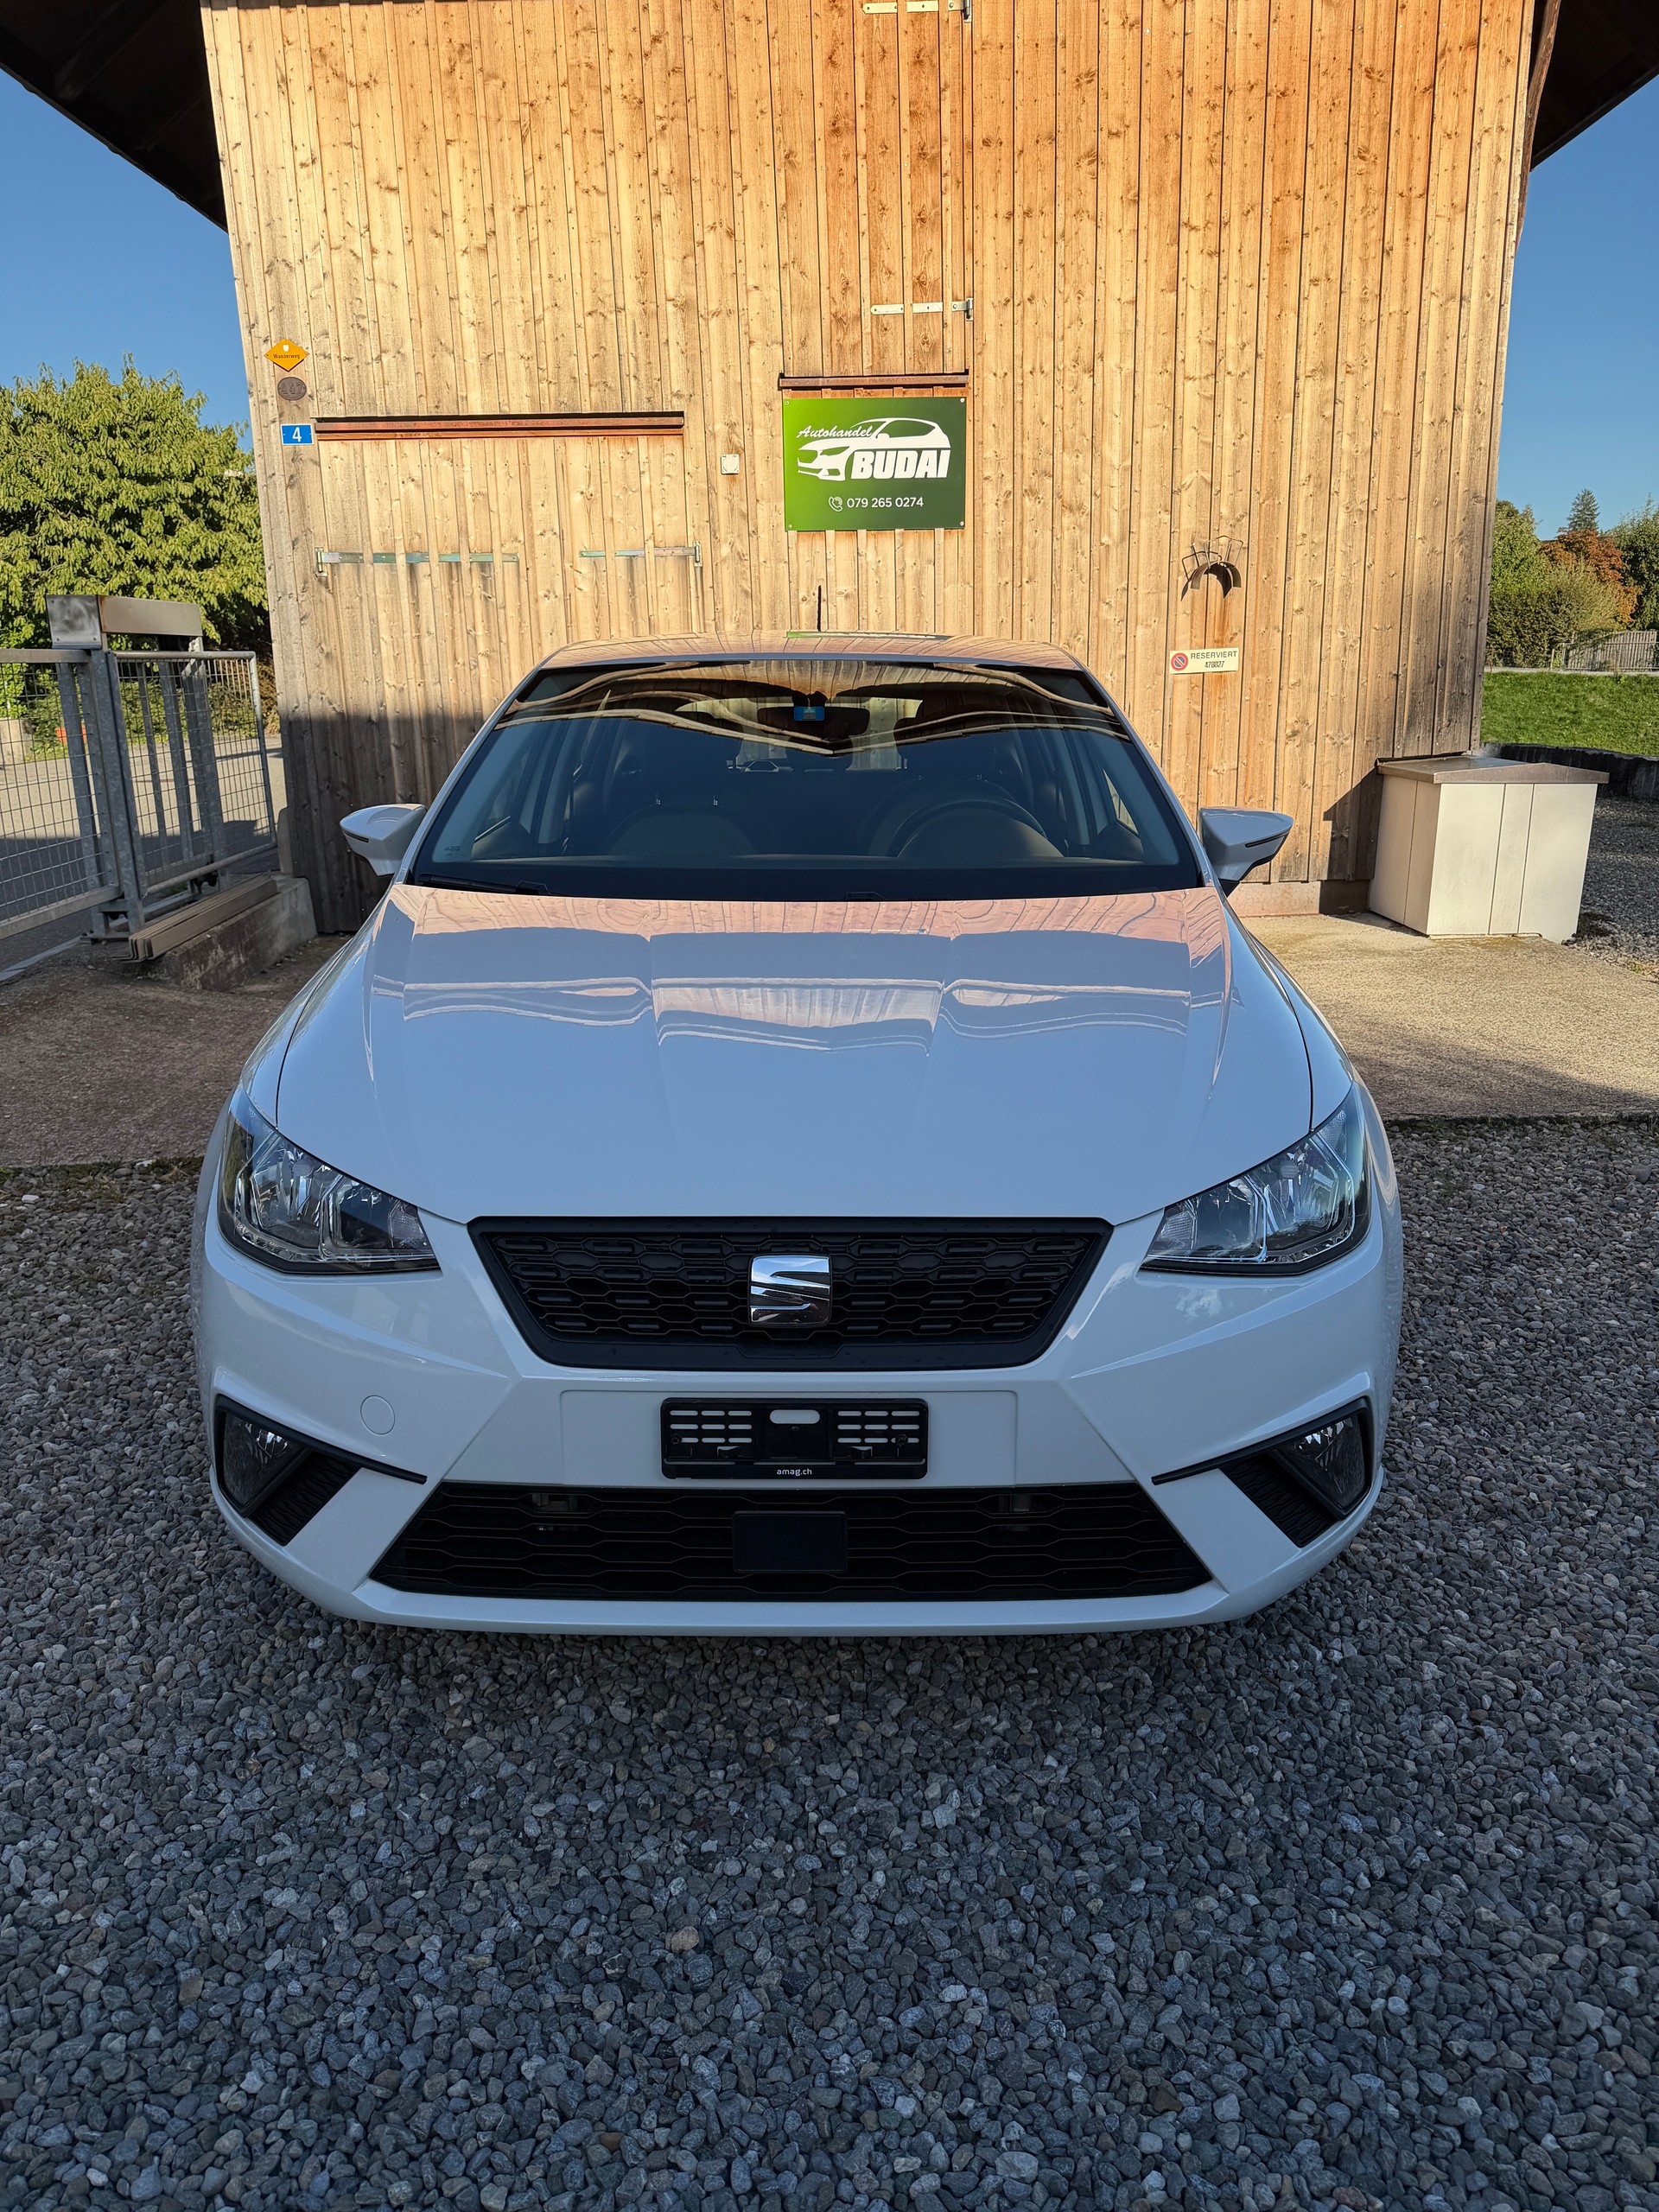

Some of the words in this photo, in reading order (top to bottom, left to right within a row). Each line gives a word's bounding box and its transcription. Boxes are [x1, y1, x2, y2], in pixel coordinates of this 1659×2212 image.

[292, 426, 302, 442] 4
[797, 425, 873, 438] Autohandel
[851, 449, 951, 480] BUDAI
[847, 498, 868, 508] 079
[871, 498, 893, 508] 265
[895, 497, 924, 507] 0274
[1190, 651, 1237, 659] RESERVIERT
